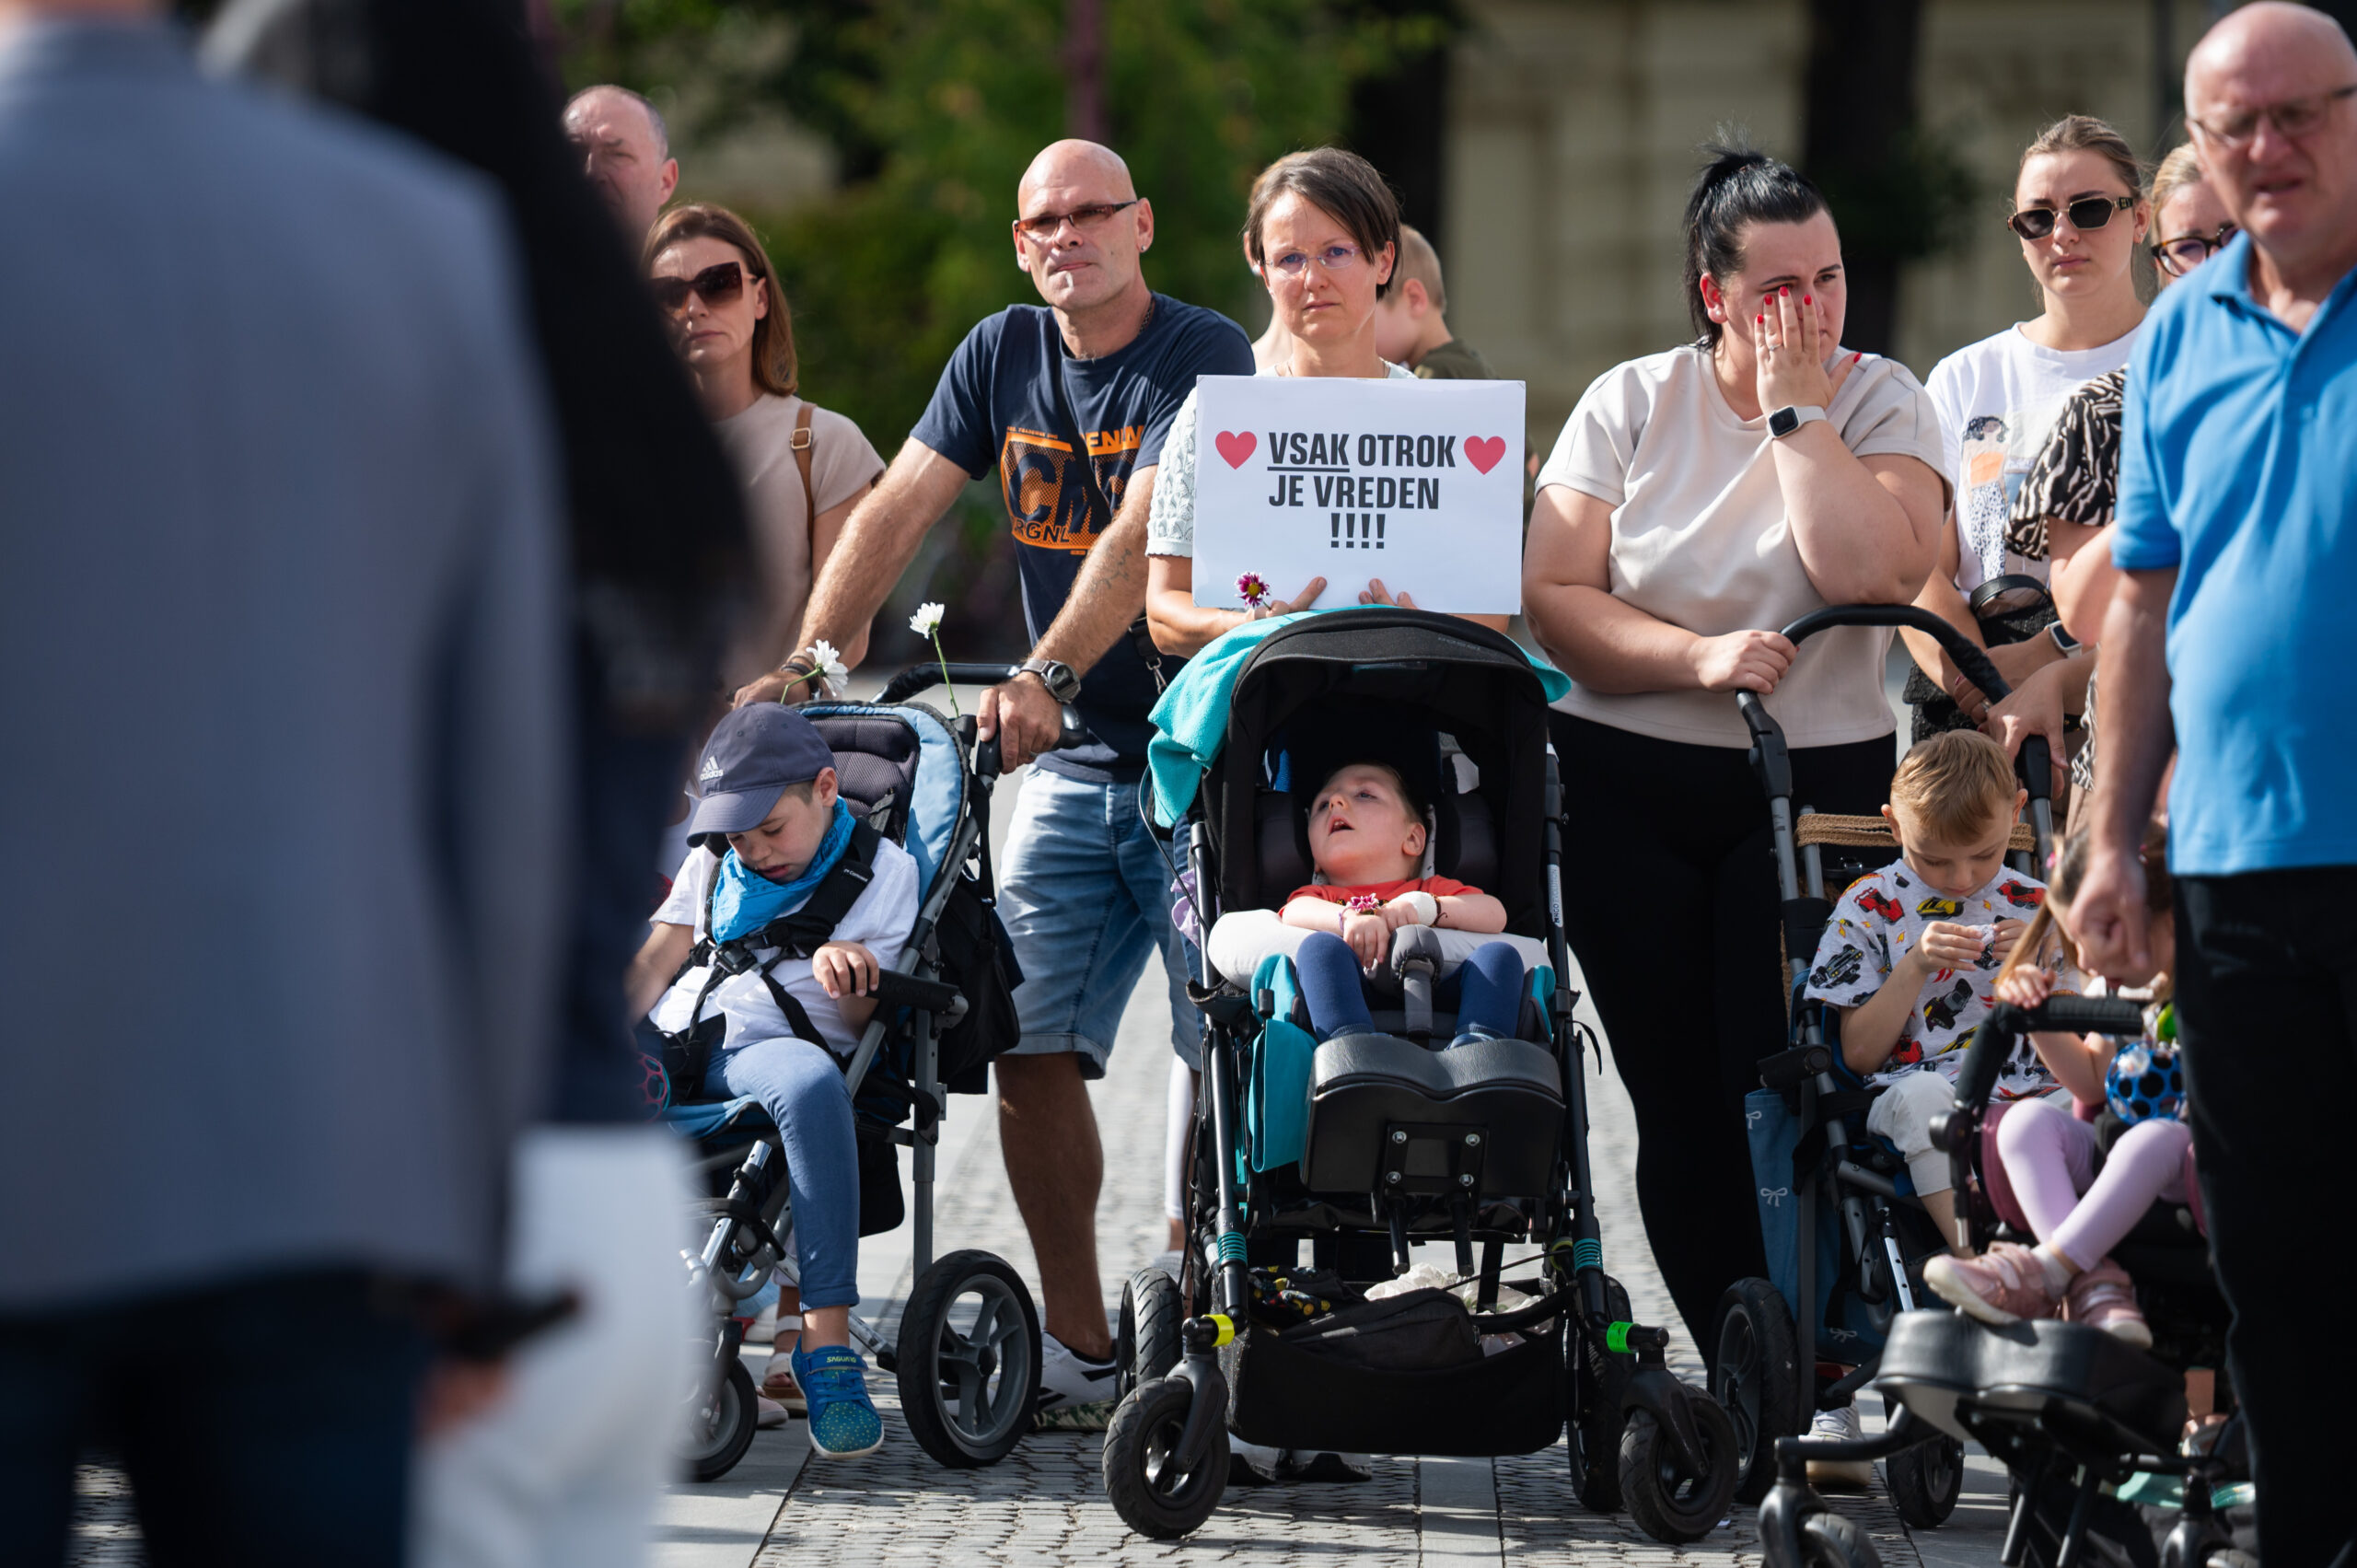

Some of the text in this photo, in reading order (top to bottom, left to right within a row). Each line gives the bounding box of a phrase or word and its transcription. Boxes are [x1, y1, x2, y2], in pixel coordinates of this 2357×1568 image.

[1268, 432, 1457, 468] VSAK OTROK
[1268, 474, 1440, 509] JE VREDEN
[1330, 513, 1386, 549] !!!!
[700, 769, 724, 782] adidas
